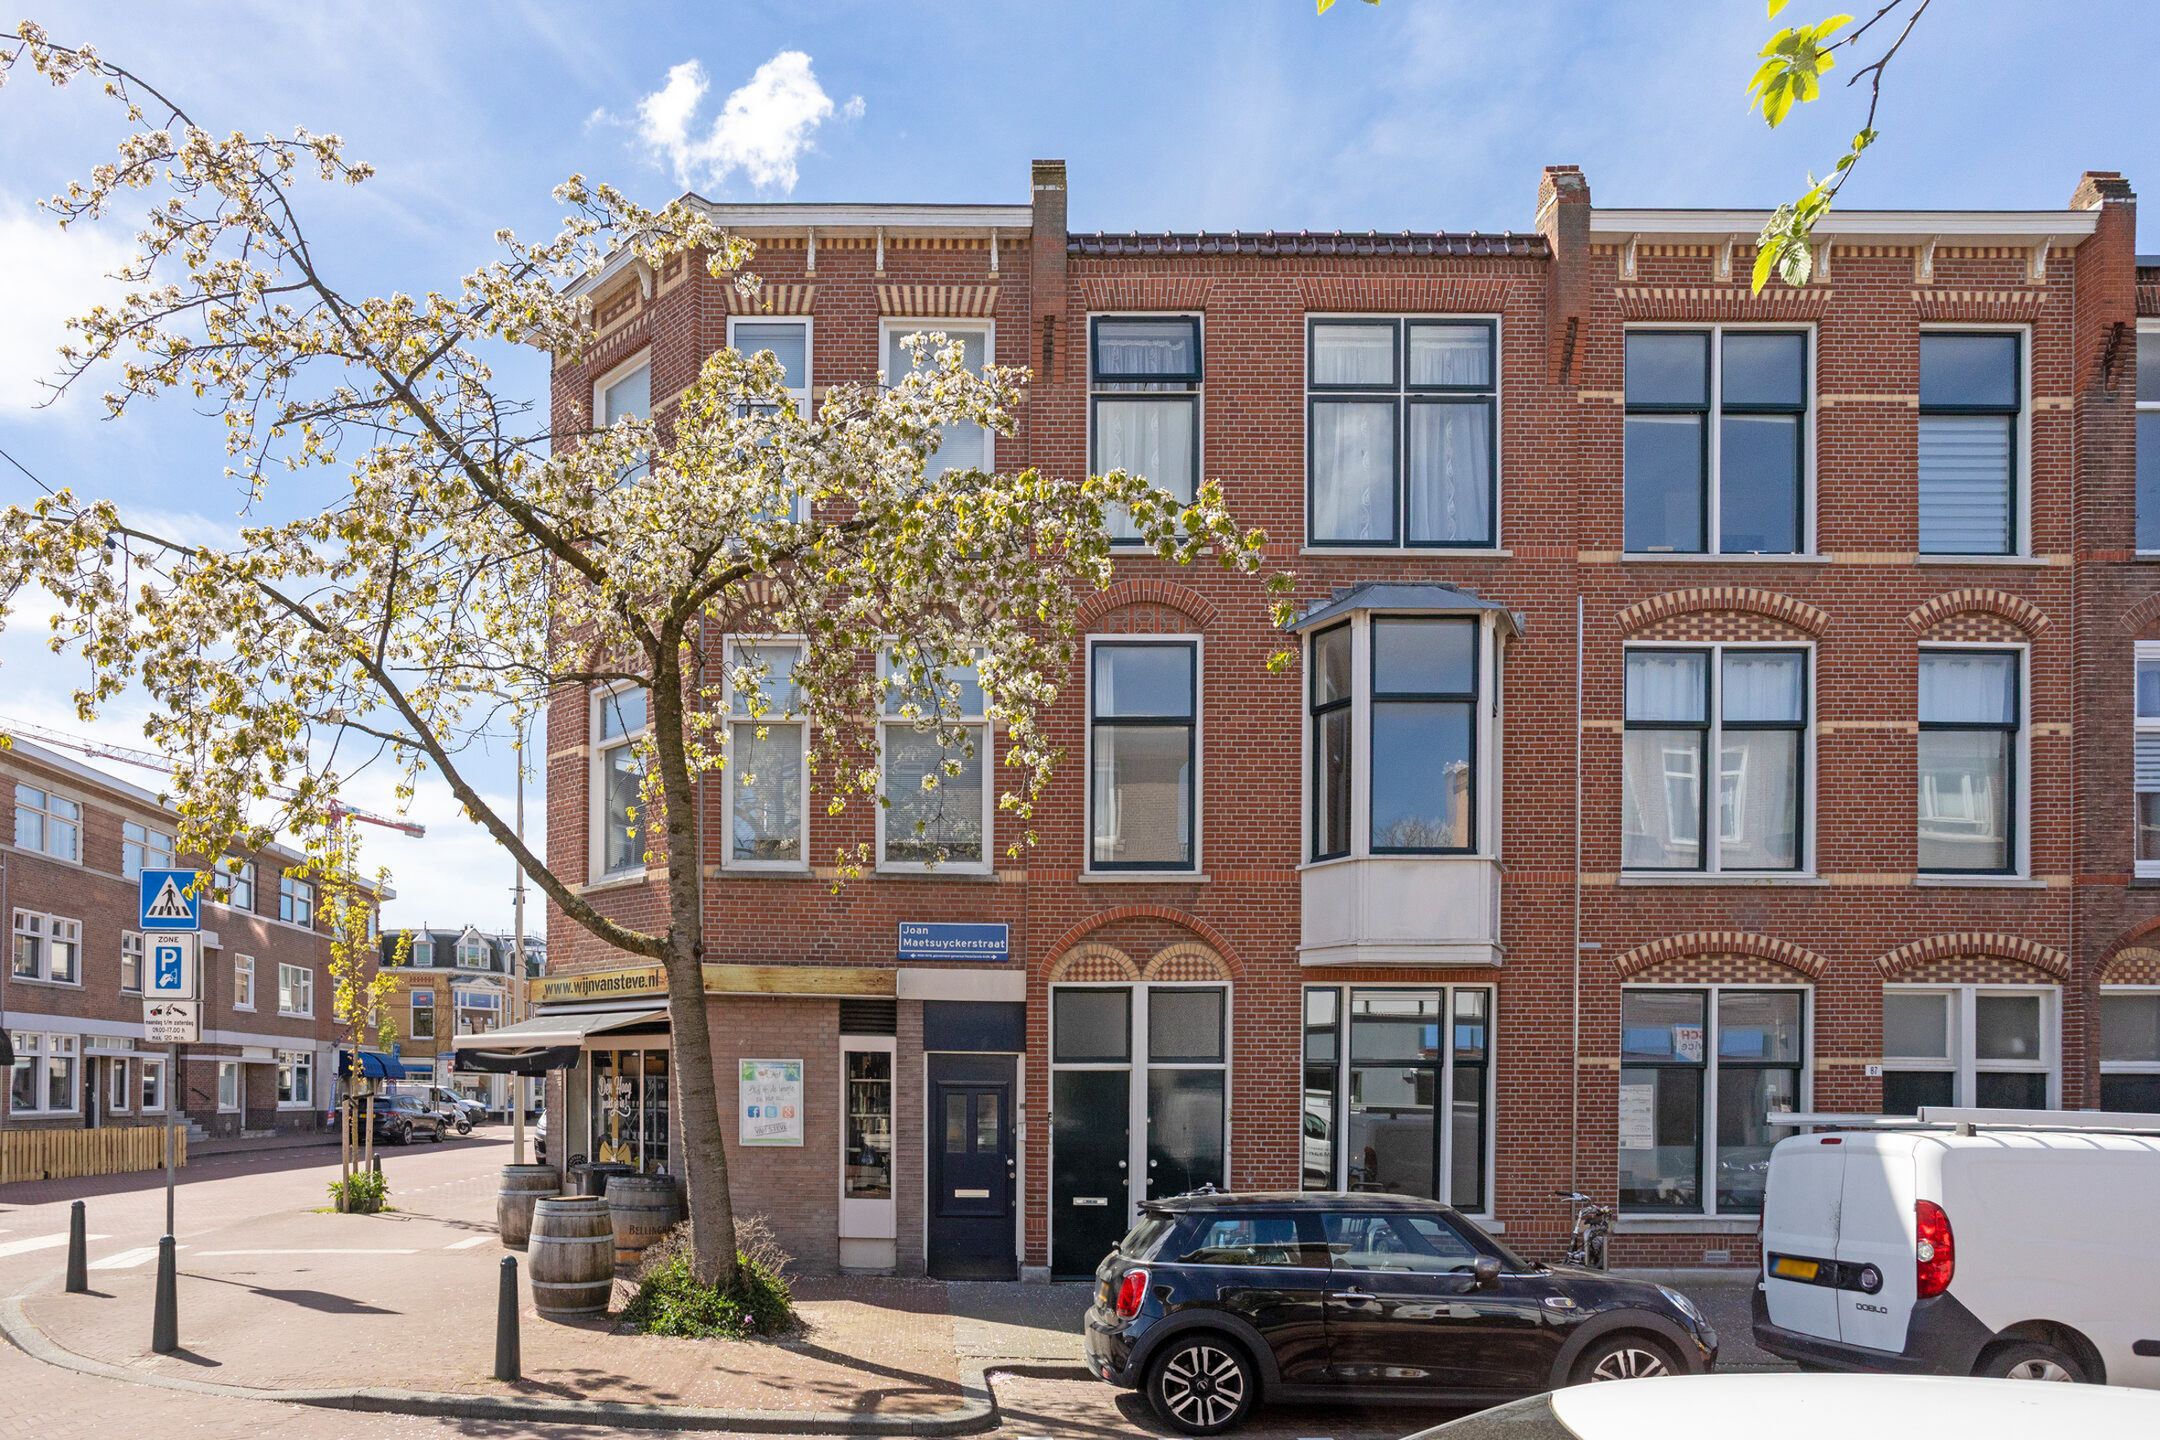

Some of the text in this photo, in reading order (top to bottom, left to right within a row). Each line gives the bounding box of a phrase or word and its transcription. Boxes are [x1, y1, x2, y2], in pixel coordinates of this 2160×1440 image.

[902, 925, 929, 935] Joan
[902, 937, 1006, 949] Maetsuyckerstraat
[161, 949, 177, 971] P
[544, 968, 659, 996] www.wijnvansteve.nl
[1870, 1066, 1878, 1075] 87
[1855, 1302, 1888, 1314] DOBLO
